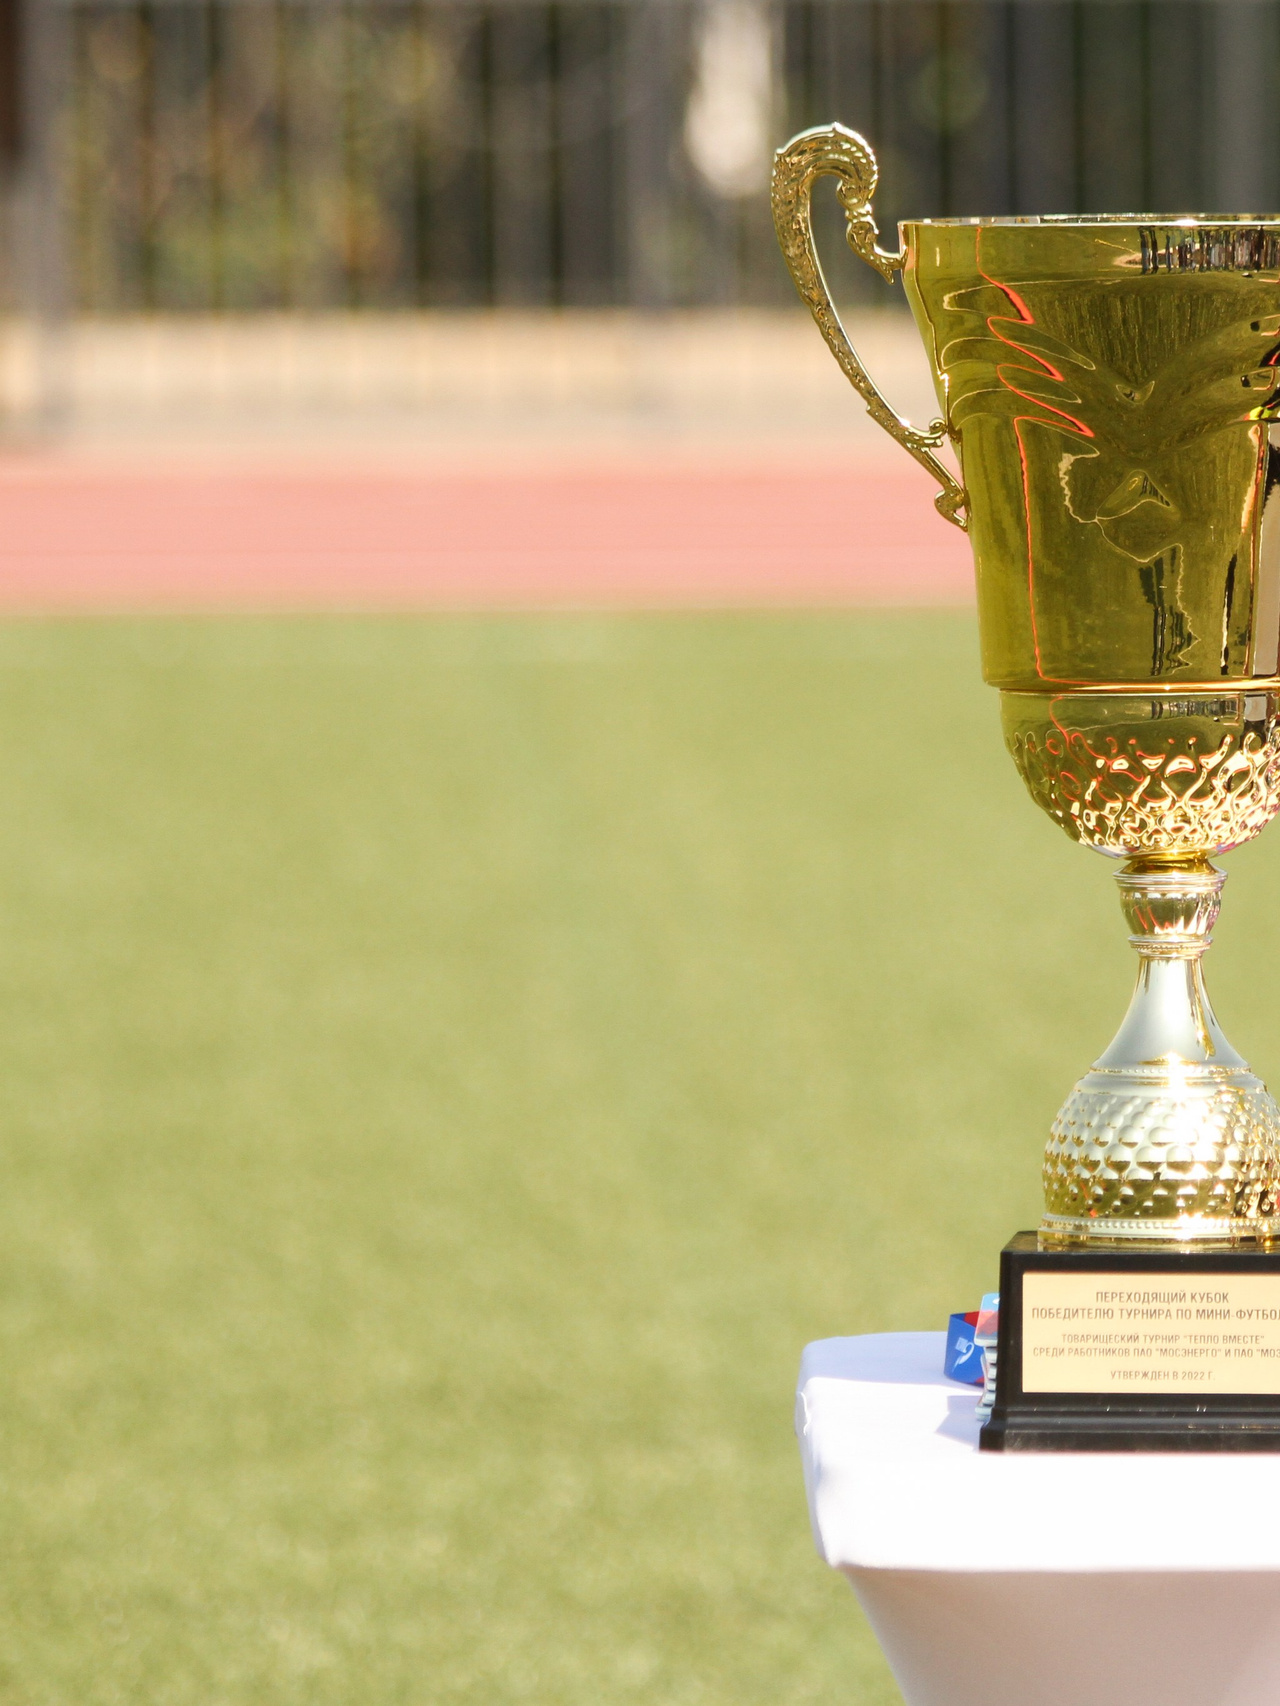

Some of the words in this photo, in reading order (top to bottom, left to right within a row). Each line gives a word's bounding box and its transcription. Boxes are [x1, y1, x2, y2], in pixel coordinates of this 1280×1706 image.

[1096, 1290, 1186, 1304] ПЕРЕХОДЯЩИЙ
[1190, 1292, 1230, 1304] КУБОК
[1032, 1308, 1114, 1321] ПОБЕДИТЕЛЮ
[1119, 1308, 1172, 1320] ТУРНИРА
[1176, 1309, 1192, 1320] ПО
[1062, 1332, 1139, 1345] ТОВАРИЩЕСКИЙ
[1142, 1334, 1180, 1344] ТУРНИР
[1183, 1334, 1220, 1344] "ТЕПЛО
[1222, 1335, 1264, 1344] ВМЕСТЕ"
[1033, 1347, 1065, 1358] СРЕДИ
[1068, 1348, 1130, 1358] РАБОТНИКОВ
[1133, 1348, 1152, 1358] ПАО
[1155, 1348, 1222, 1358] "МОСЭНЕРГО"
[1224, 1348, 1231, 1358] И
[1234, 1348, 1254, 1358] ПАО
[1110, 1370, 1170, 1381] УТВЕРЖДЕН
[1172, 1370, 1178, 1380] В
[1181, 1370, 1205, 1380] 2022
[1208, 1371, 1216, 1381] Г.
